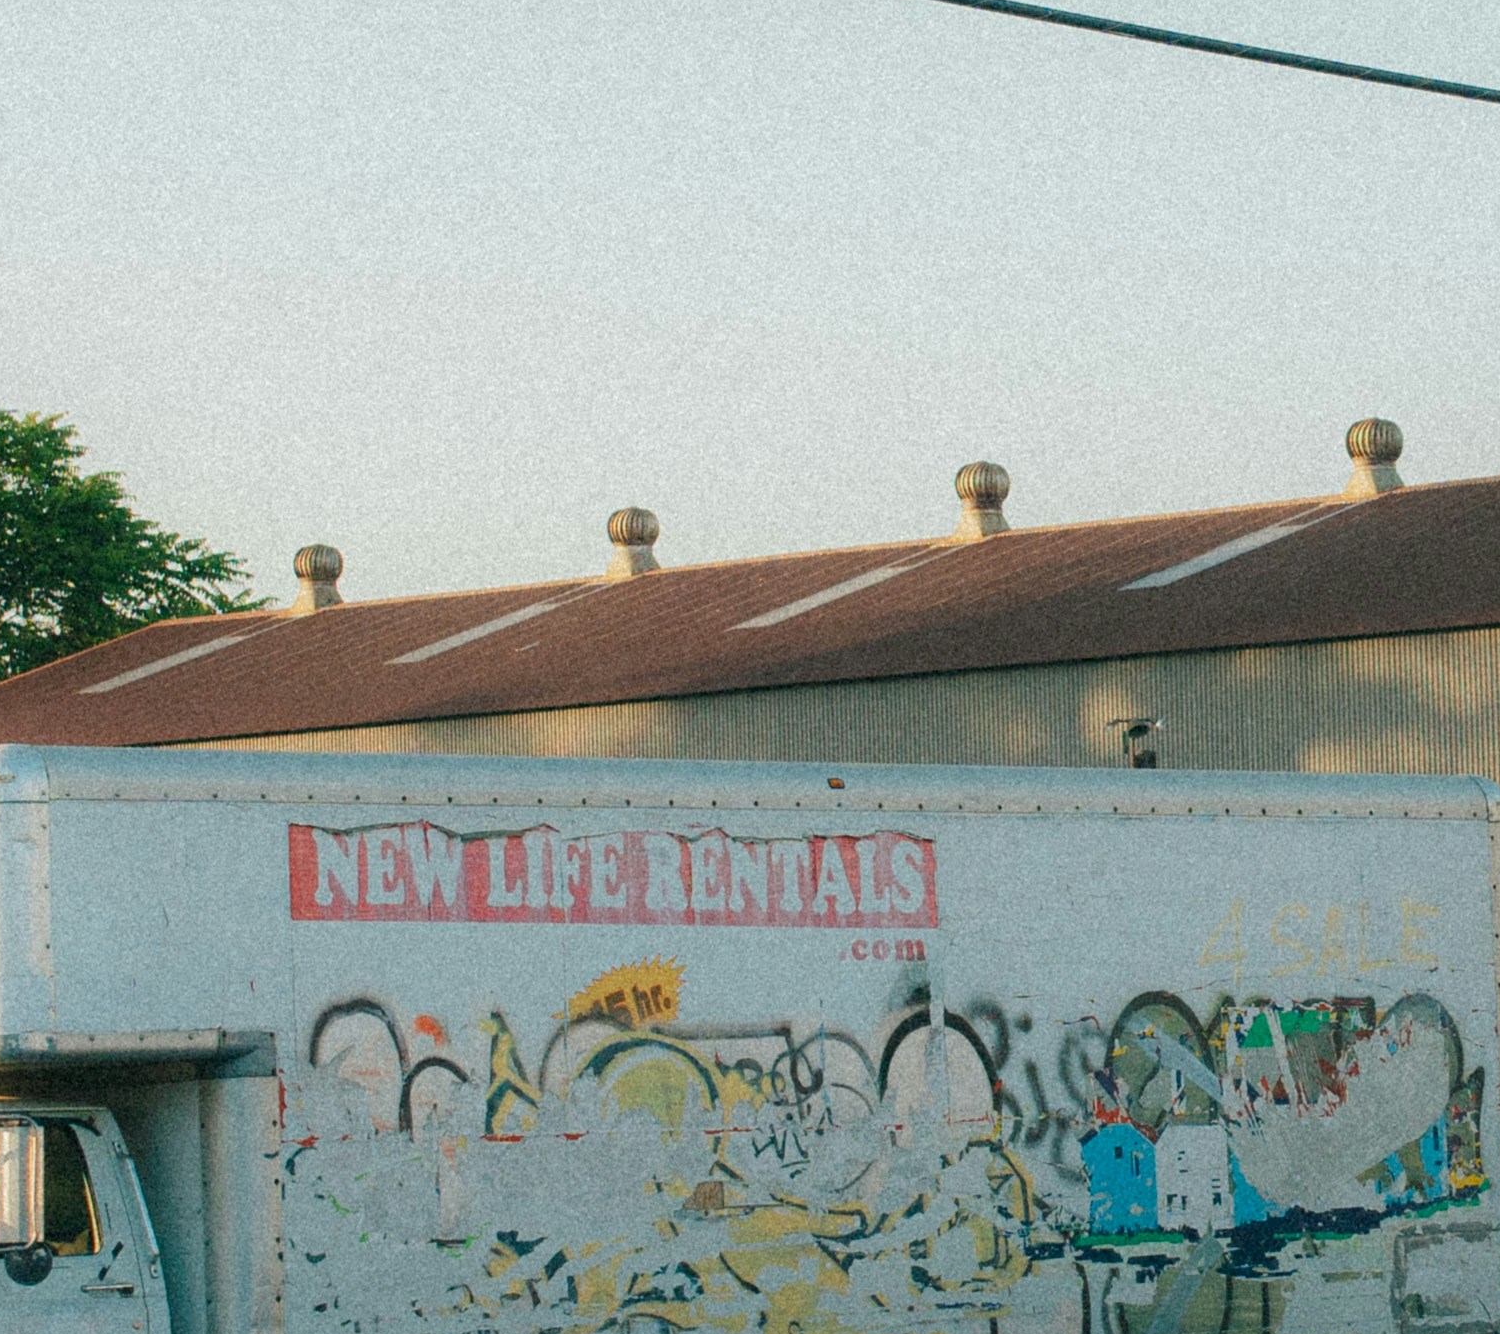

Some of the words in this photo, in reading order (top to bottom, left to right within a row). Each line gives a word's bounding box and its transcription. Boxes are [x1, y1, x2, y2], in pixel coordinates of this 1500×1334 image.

[312, 829, 463, 909] NEW
[486, 831, 628, 910] LIFE
[644, 831, 926, 915] RENTALS
[1270, 897, 1441, 978] SALE
